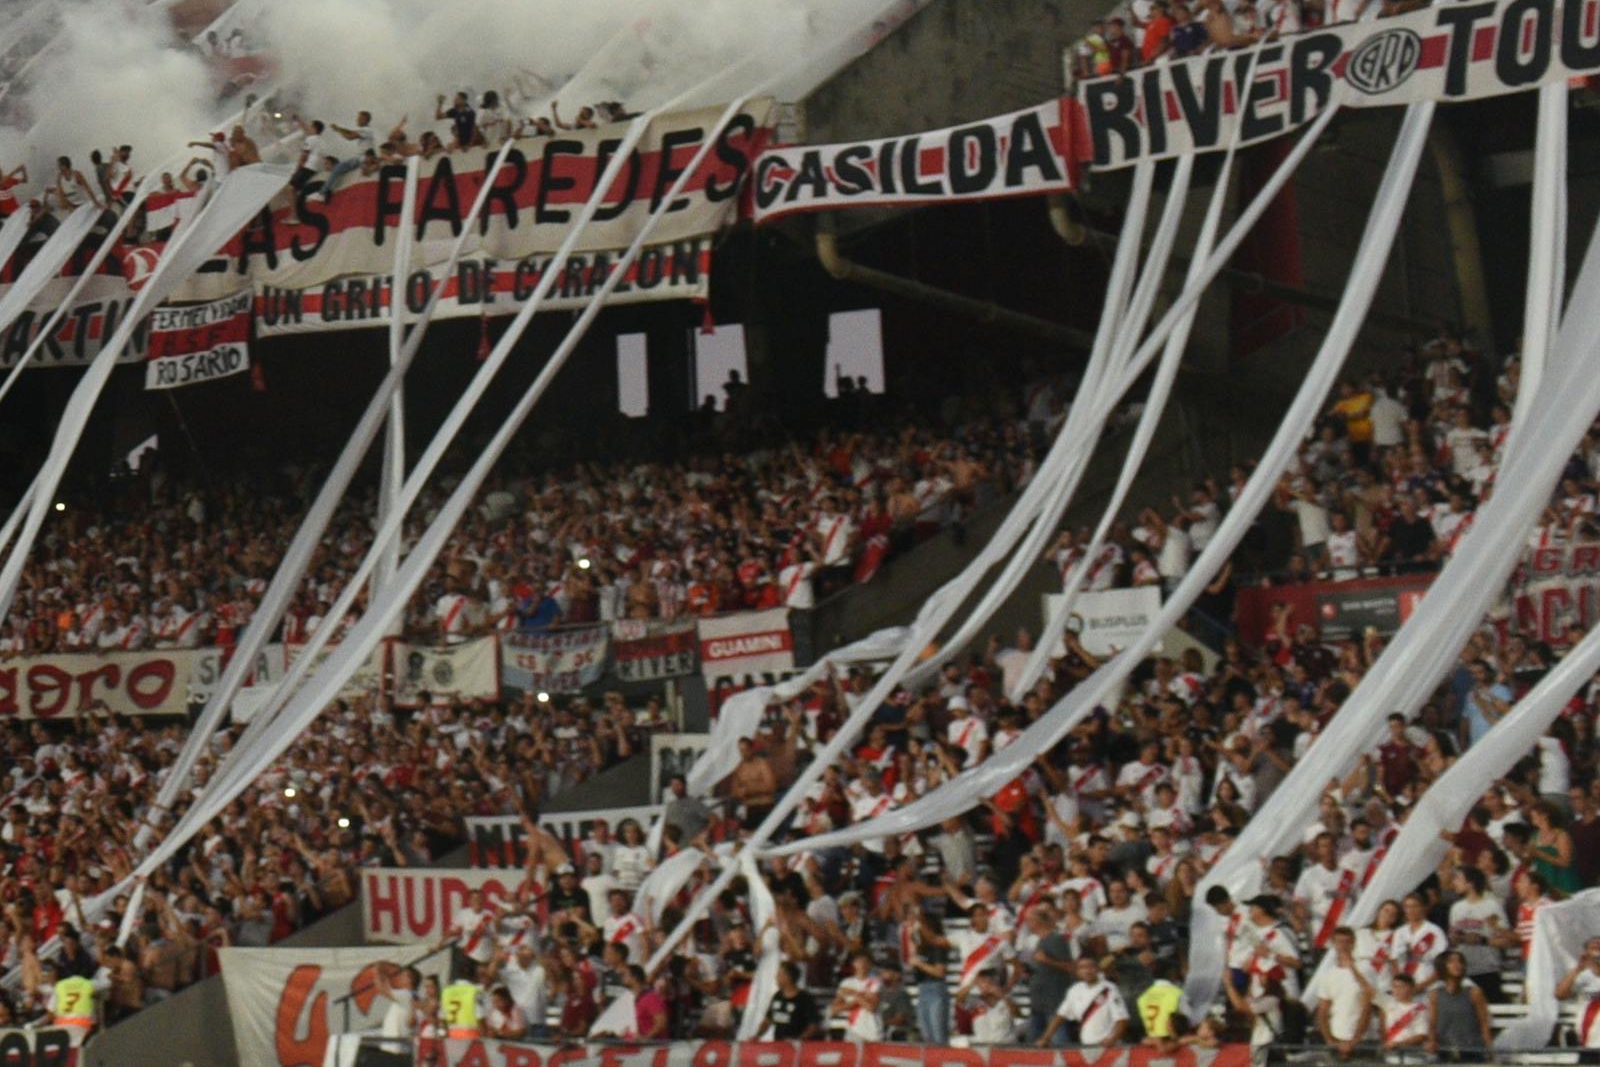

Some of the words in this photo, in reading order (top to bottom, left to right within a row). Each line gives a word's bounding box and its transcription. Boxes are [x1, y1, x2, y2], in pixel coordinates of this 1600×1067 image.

[1083, 31, 1343, 166] RIVER
[374, 111, 756, 246] PAREDES
[754, 109, 1064, 209] CASILDA
[262, 285, 302, 326] UN
[321, 269, 432, 322] GRIO
[457, 256, 497, 305] DE
[157, 346, 241, 386] ROSARIO
